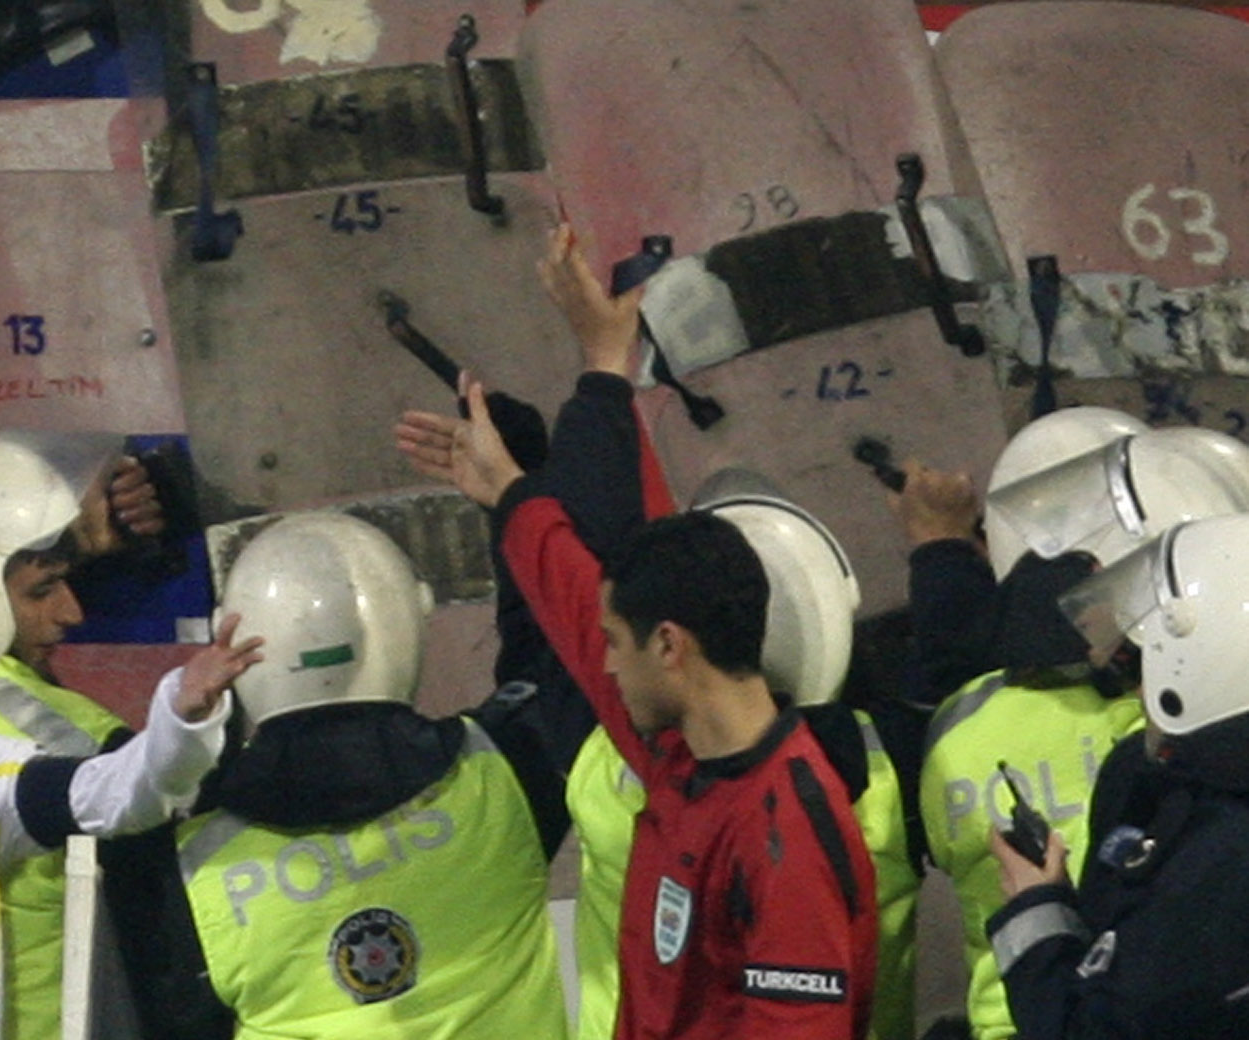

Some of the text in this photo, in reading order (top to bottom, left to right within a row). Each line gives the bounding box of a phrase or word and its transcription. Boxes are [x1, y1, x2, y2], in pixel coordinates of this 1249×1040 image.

[1122, 183, 1229, 266] 63
[3, 314, 45, 355] 13
[744, 968, 843, 995] TURKCELL
